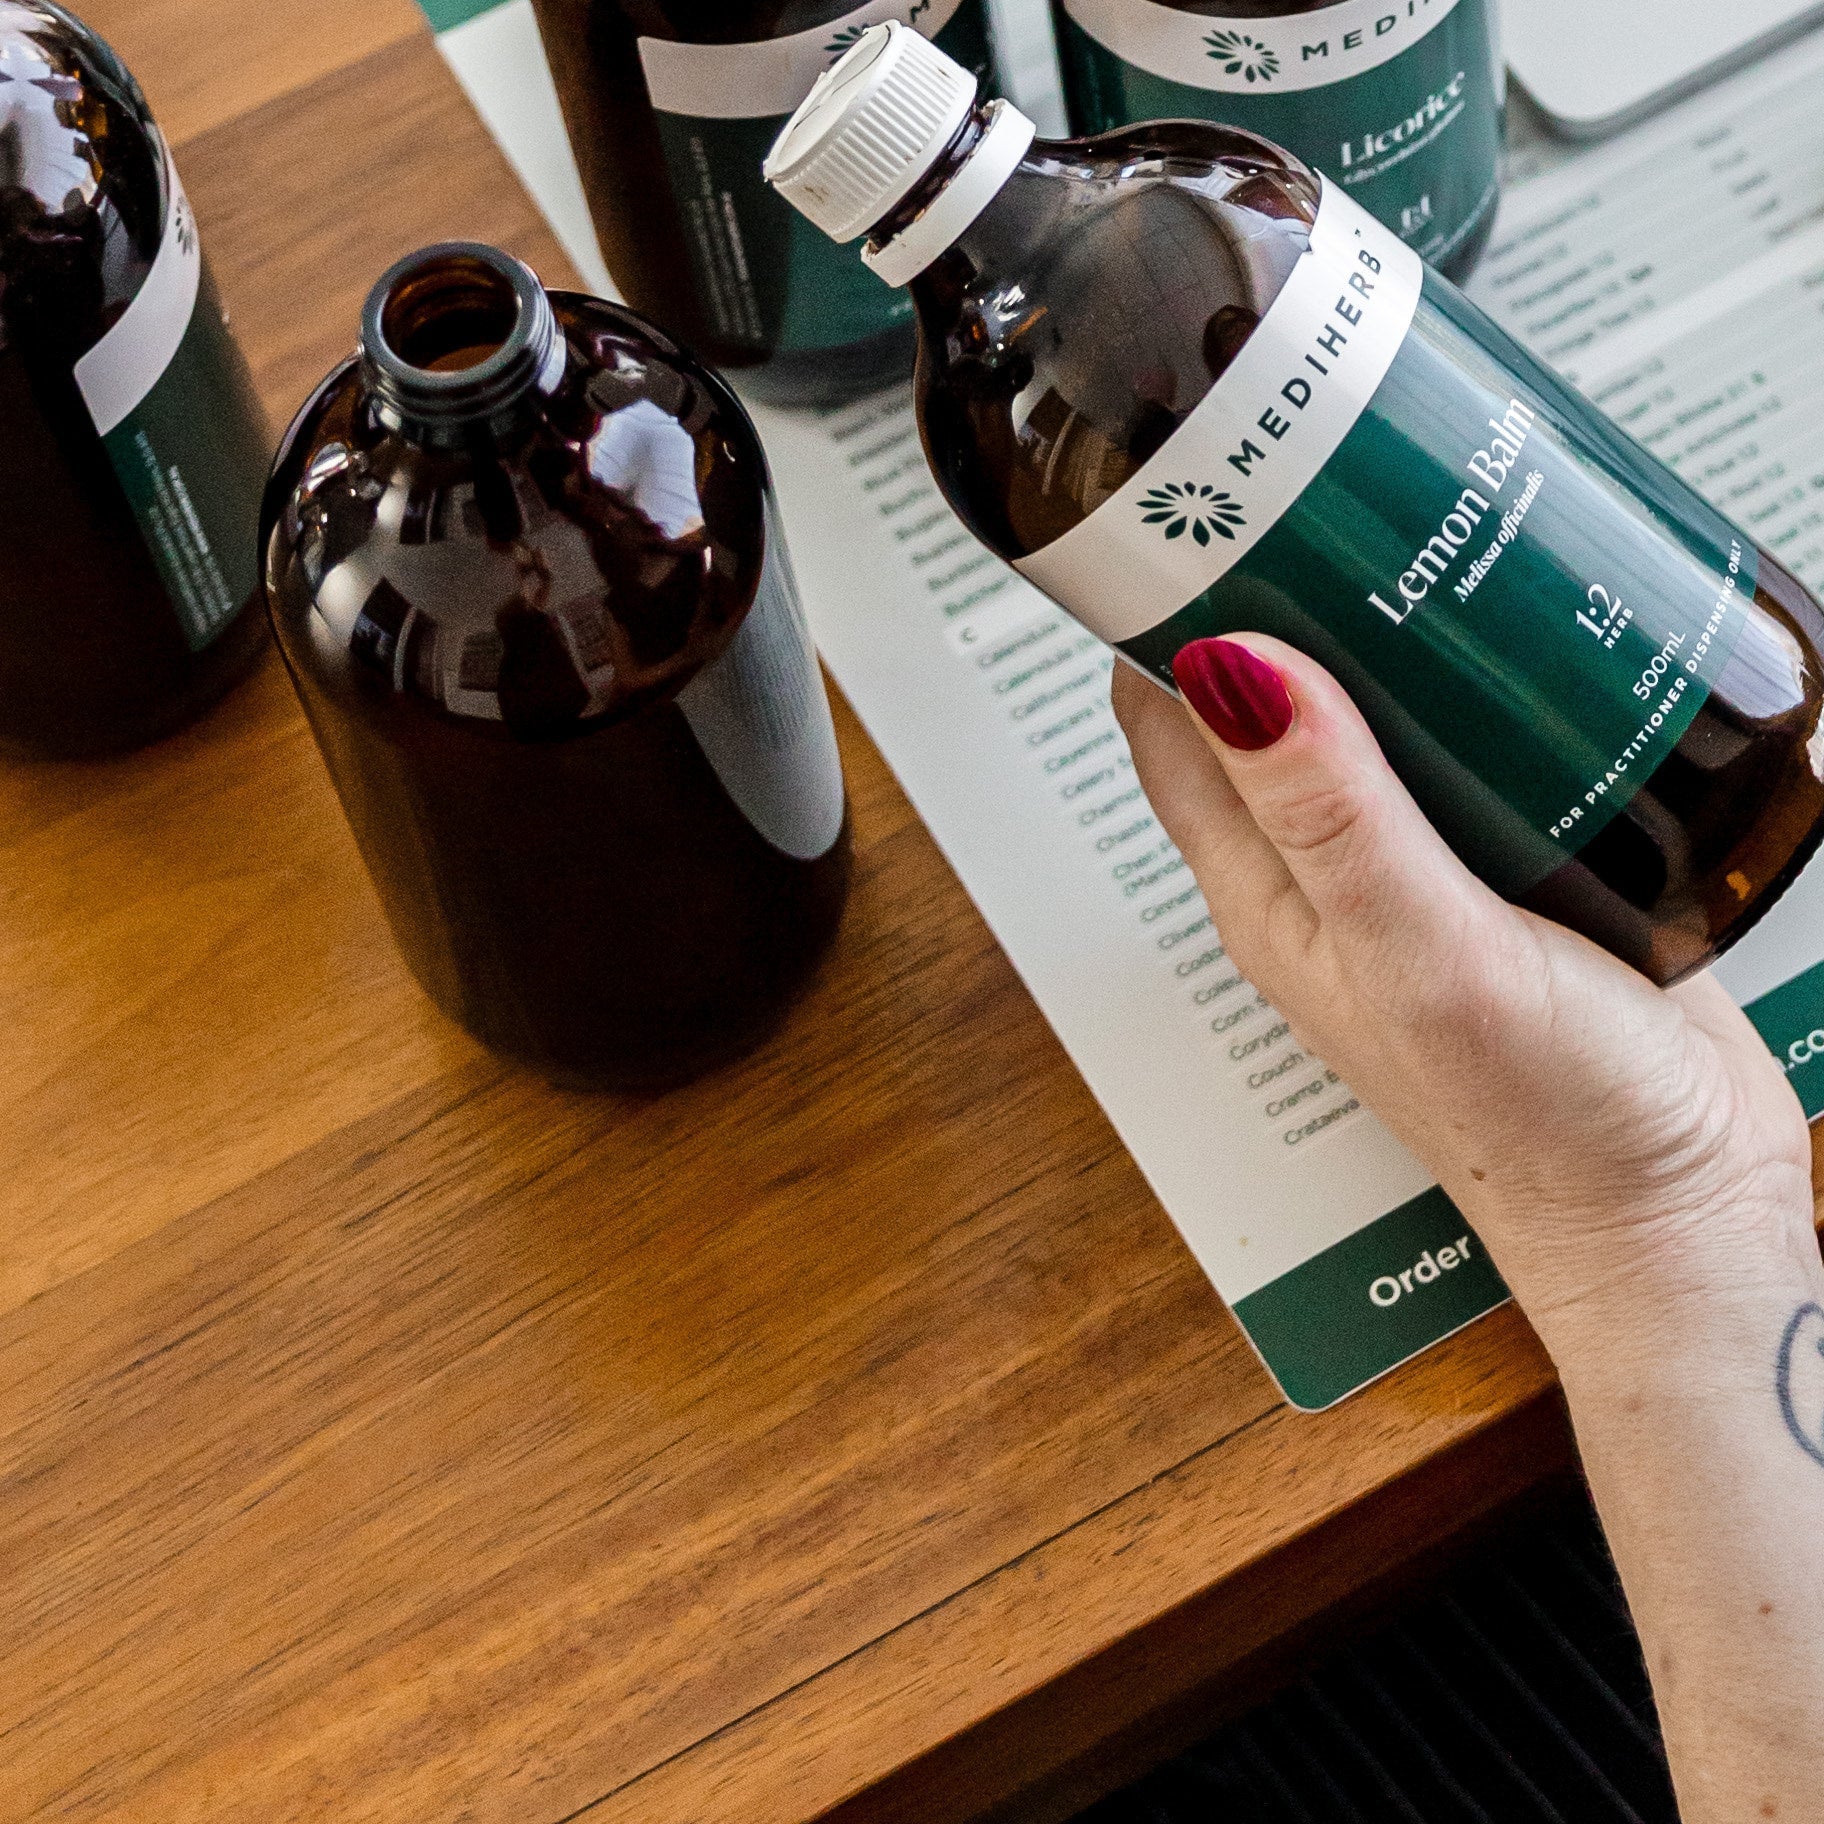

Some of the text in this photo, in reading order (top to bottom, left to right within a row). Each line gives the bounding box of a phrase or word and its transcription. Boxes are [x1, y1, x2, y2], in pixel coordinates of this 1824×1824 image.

[1227, 249, 1381, 477] MEDIHERB
[1367, 398, 1535, 626] Lemon Balm
[1453, 468, 1544, 603] Melissa officinalis
[1575, 582, 1622, 640] 1:2
[1603, 607, 1634, 649] HERB
[1549, 538, 1743, 838] FOR PRACTITIONER DISPENSING ONLY
[1633, 630, 1686, 700] 500mL
[1247, 1051, 1305, 1089] Couch
[1265, 1079, 1325, 1117] Cramp
[1368, 1235, 1472, 1308] Order
